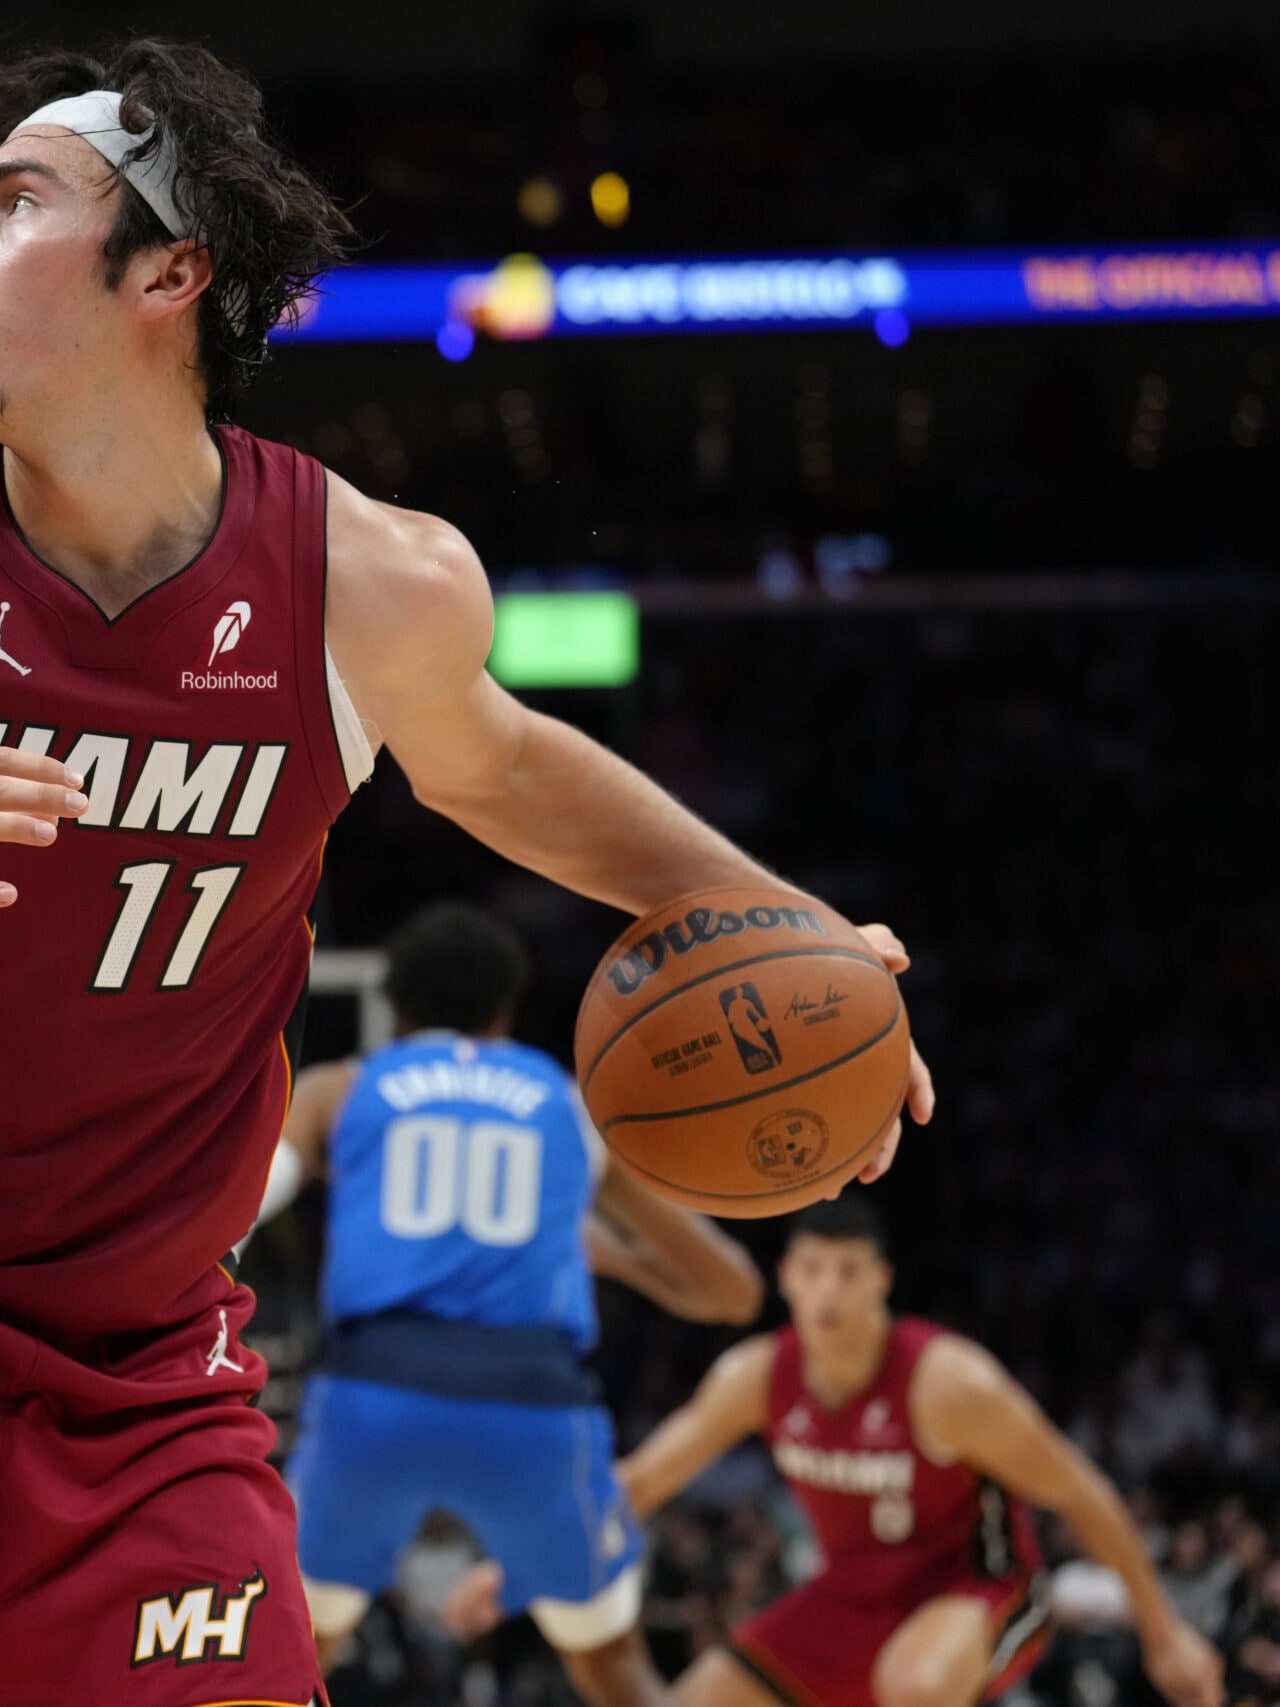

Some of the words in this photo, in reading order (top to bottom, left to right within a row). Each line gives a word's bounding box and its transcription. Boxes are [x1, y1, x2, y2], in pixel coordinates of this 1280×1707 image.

[180, 670, 278, 690] Robinhood
[86, 856, 249, 994] 11
[606, 906, 828, 997] Wilson
[380, 1114, 545, 1247] 00
[131, 1560, 268, 1670] MH
